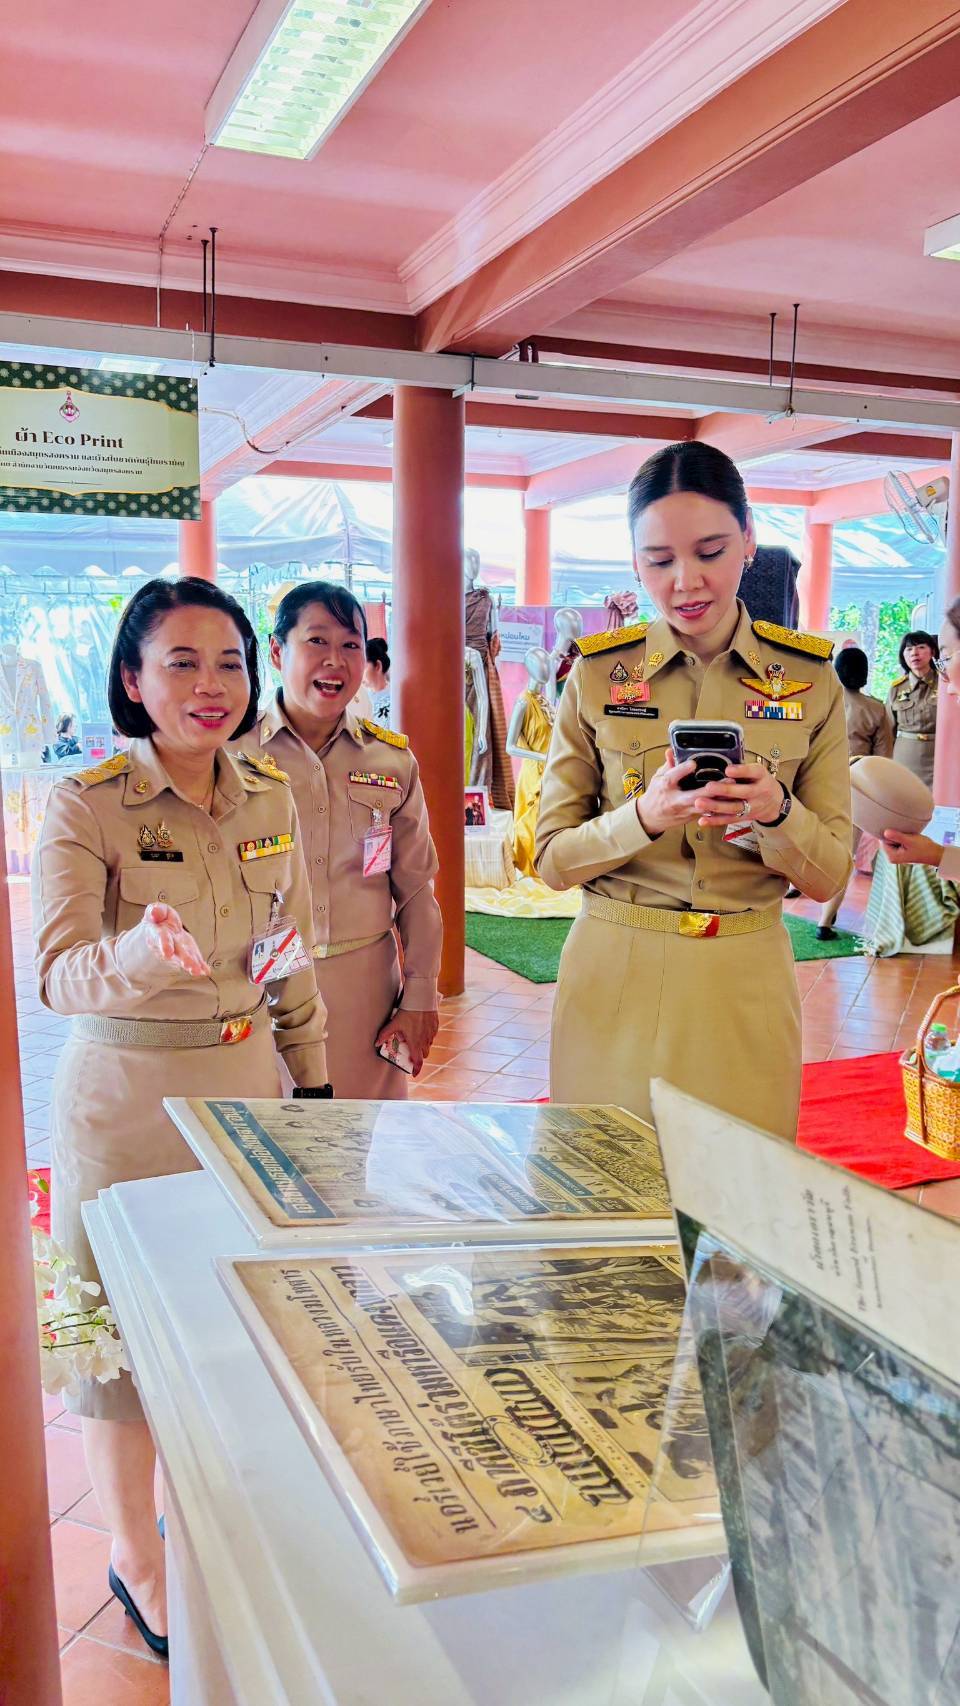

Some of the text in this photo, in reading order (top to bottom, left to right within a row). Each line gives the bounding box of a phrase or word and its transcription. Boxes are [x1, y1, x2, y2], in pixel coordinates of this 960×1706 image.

[15, 427, 124, 449] ผ้า Eco Print
